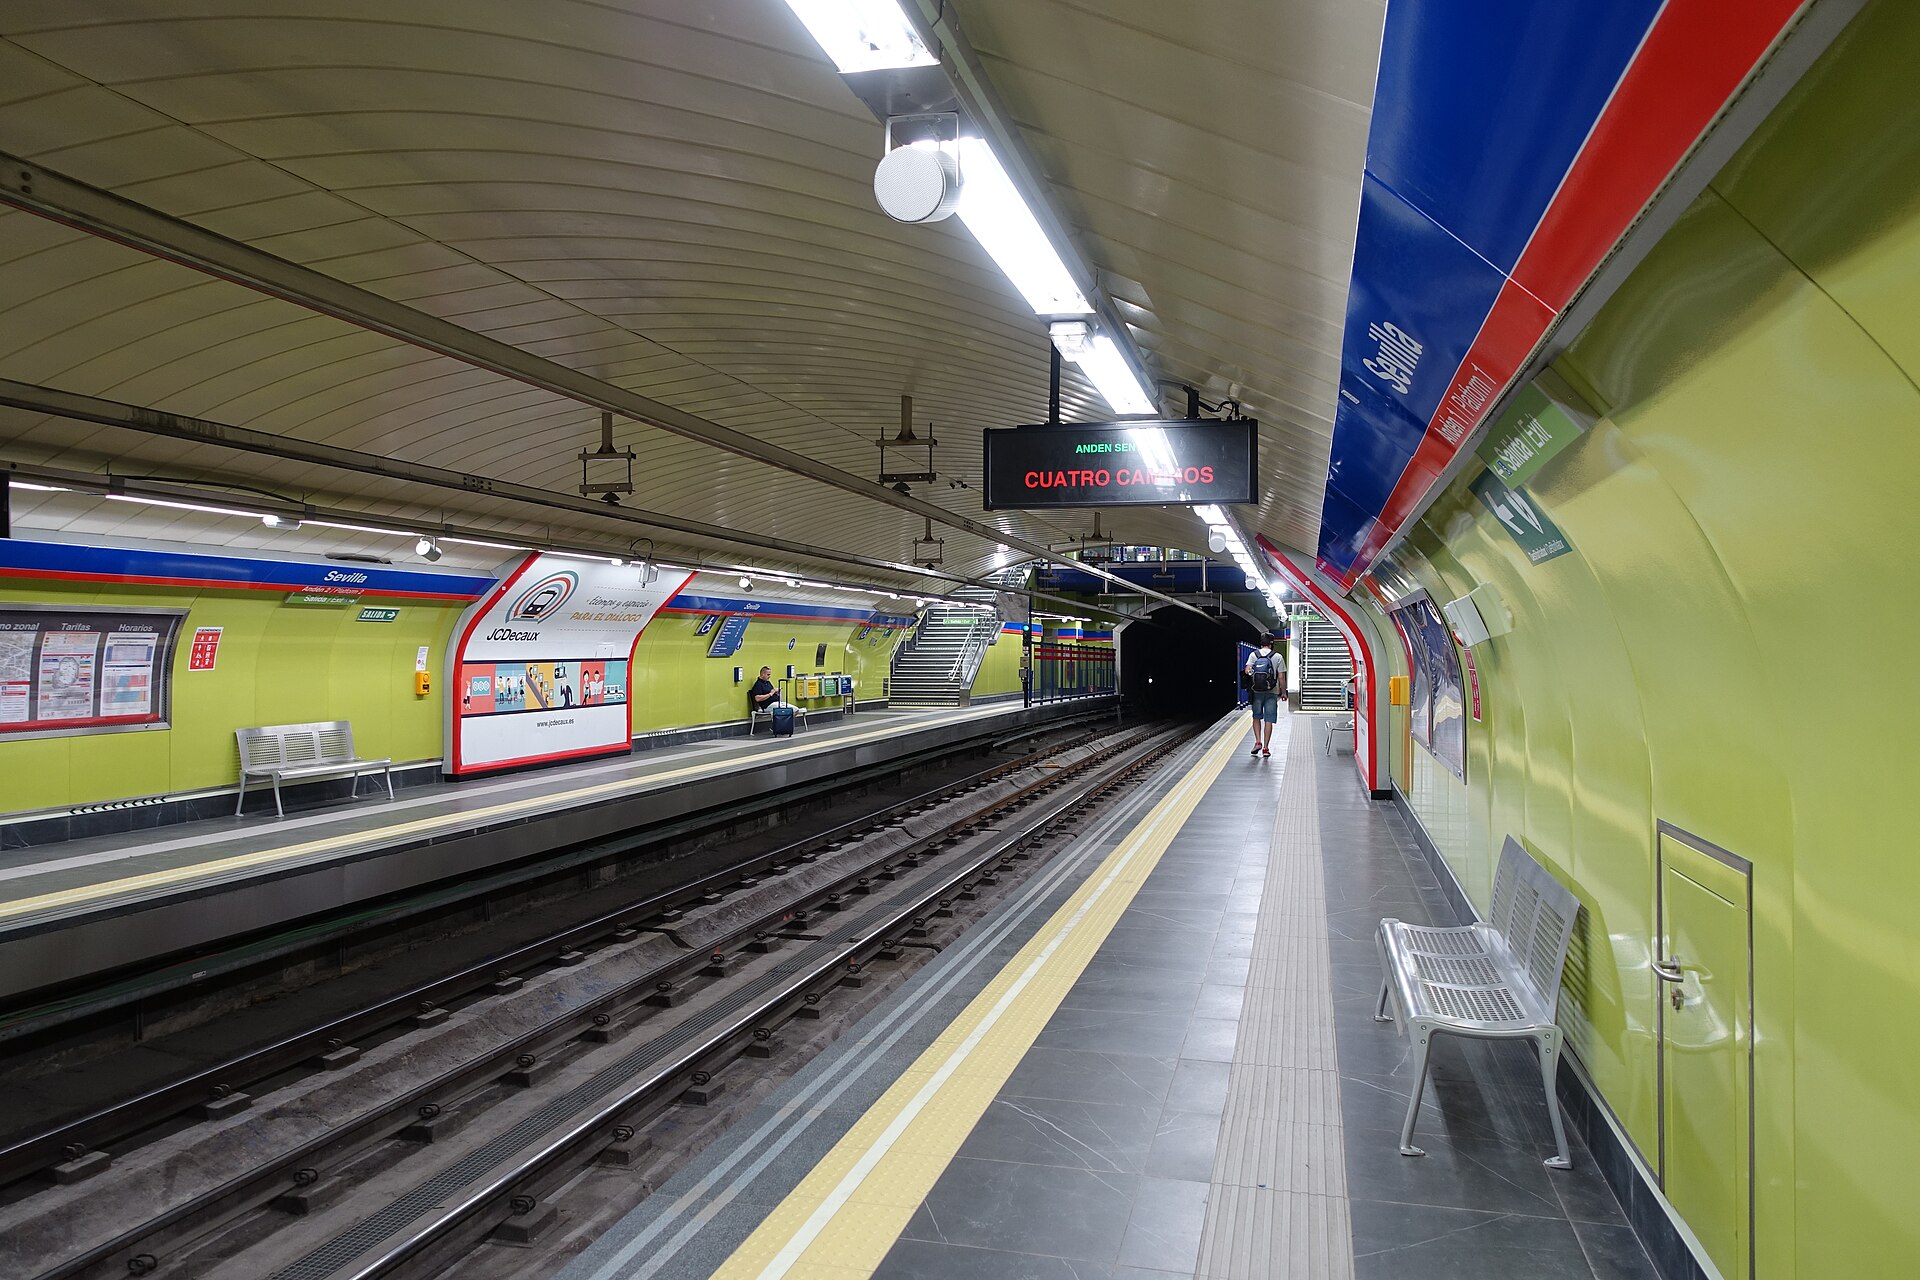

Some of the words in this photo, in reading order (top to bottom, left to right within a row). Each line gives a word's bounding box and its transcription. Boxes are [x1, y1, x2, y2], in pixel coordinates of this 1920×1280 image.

[1362, 321, 1423, 394] Sevilla
[1471, 362, 1497, 385] 1
[1450, 375, 1493, 418] Platform
[1446, 406, 1469, 425] 1
[1434, 414, 1466, 446] Andén
[1075, 444, 1112, 454] ANDEN
[1114, 443, 1136, 452] SEN
[1494, 433, 1534, 472] Salida
[1517, 413, 1552, 448] Exit
[1024, 469, 1110, 488] CUATRO
[1116, 466, 1214, 486] CAMNOS
[324, 570, 368, 584] Sevilla
[303, 595, 327, 603] Salida
[588, 595, 617, 609] tiempo
[612, 600, 622, 610] y
[361, 610, 385, 619] SALIDA
[569, 612, 594, 621] PARA
[592, 612, 605, 621] EL
[603, 611, 643, 622] DIÁLOGO
[13, 622, 40, 631] zonal
[61, 622, 91, 632] Tarifas
[118, 623, 153, 632] Horarios
[486, 628, 541, 642] JCDecaux
[536, 717, 574, 729] www.jcdecaux.es
